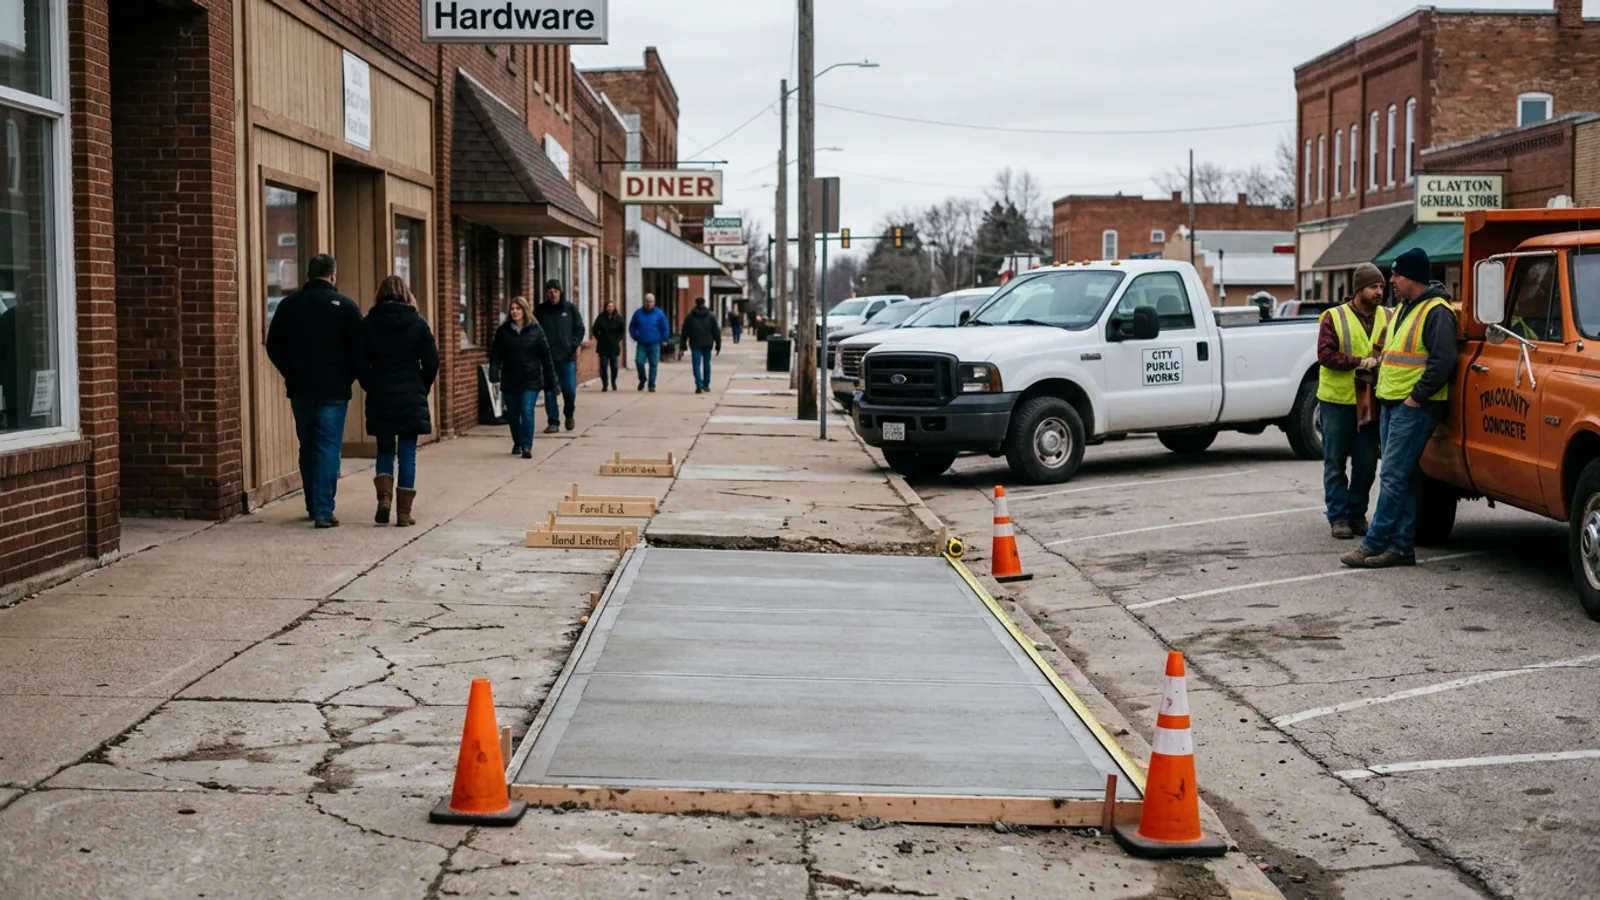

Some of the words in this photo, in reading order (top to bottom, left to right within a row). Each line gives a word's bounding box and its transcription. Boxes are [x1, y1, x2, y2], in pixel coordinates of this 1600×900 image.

[435, 2, 595, 30] Hardware
[626, 176, 714, 197] DINER
[1427, 180, 1492, 192] CLAYTON
[1420, 194, 1465, 207] GENERAL
[1467, 194, 1499, 207] STORE
[1152, 350, 1173, 360] CITY
[1146, 372, 1180, 383] WORKS
[1482, 414, 1526, 441] CONCRETE
